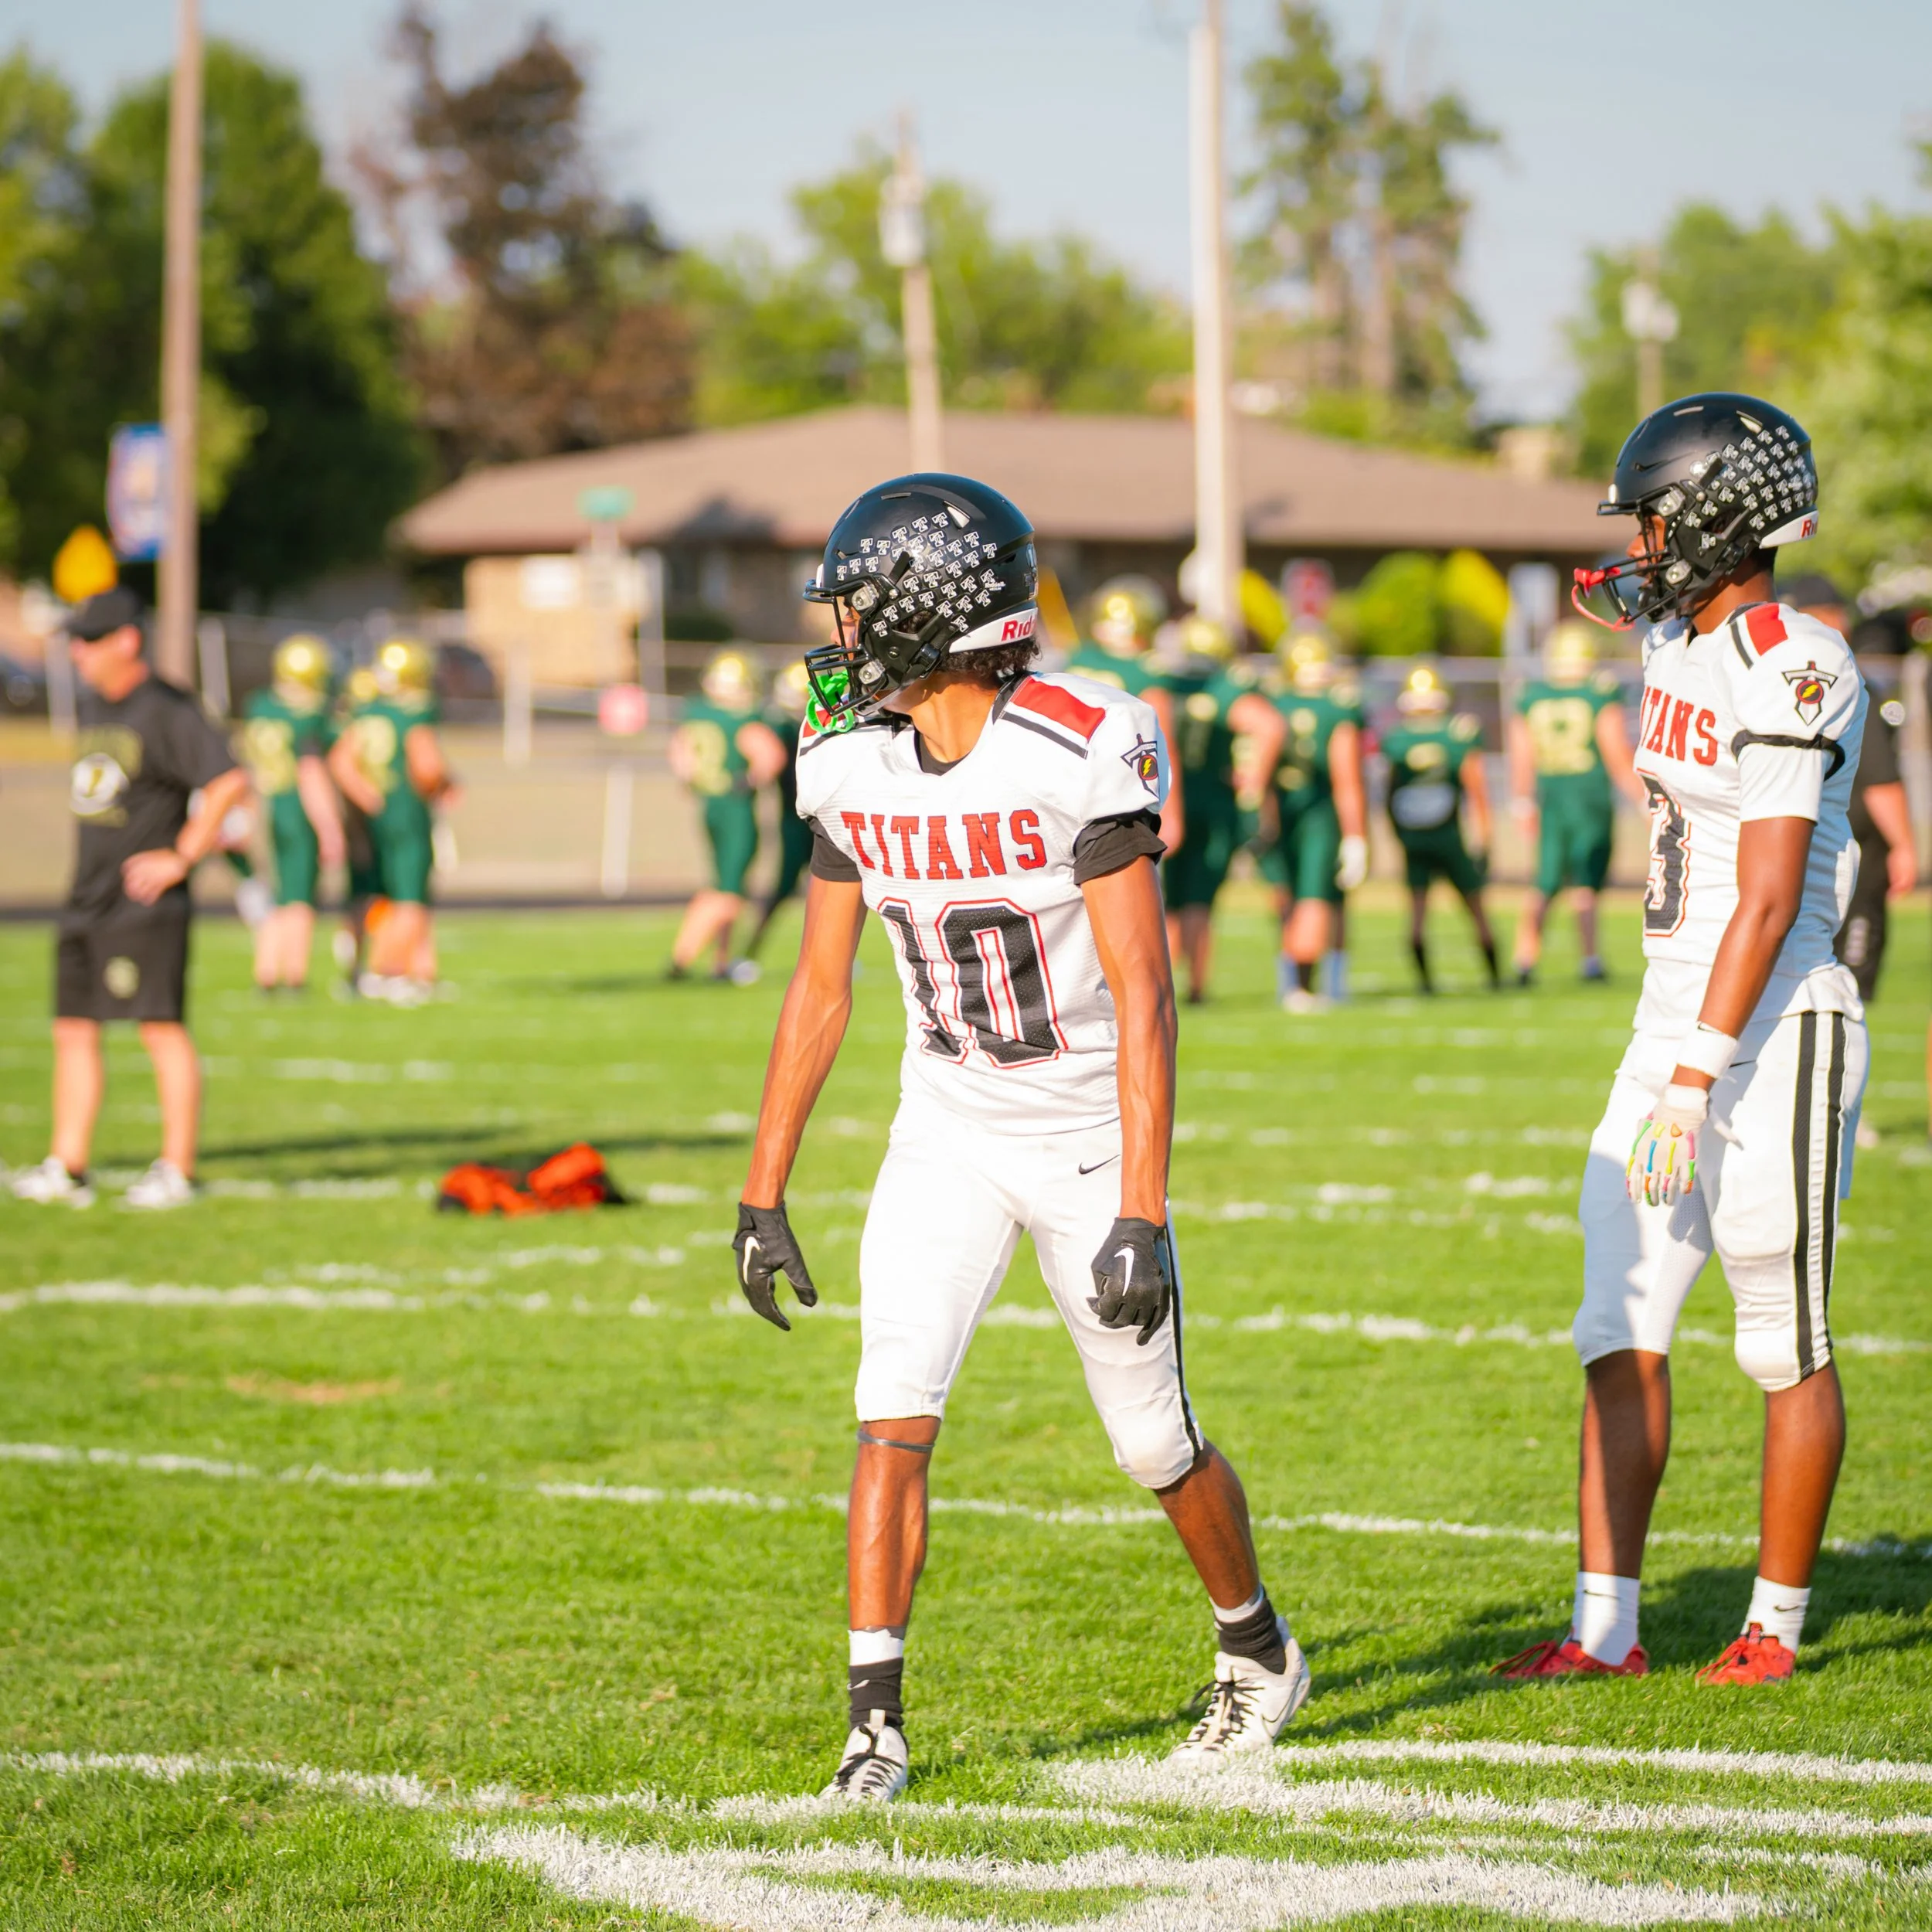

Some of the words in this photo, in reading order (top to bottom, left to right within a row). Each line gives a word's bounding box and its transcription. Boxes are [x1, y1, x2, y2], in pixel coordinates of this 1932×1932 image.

[1001, 615, 1036, 641] Rid
[1639, 685, 1718, 767] ITANS
[840, 808, 1048, 880] TITANS
[878, 896, 1070, 1070] 10
